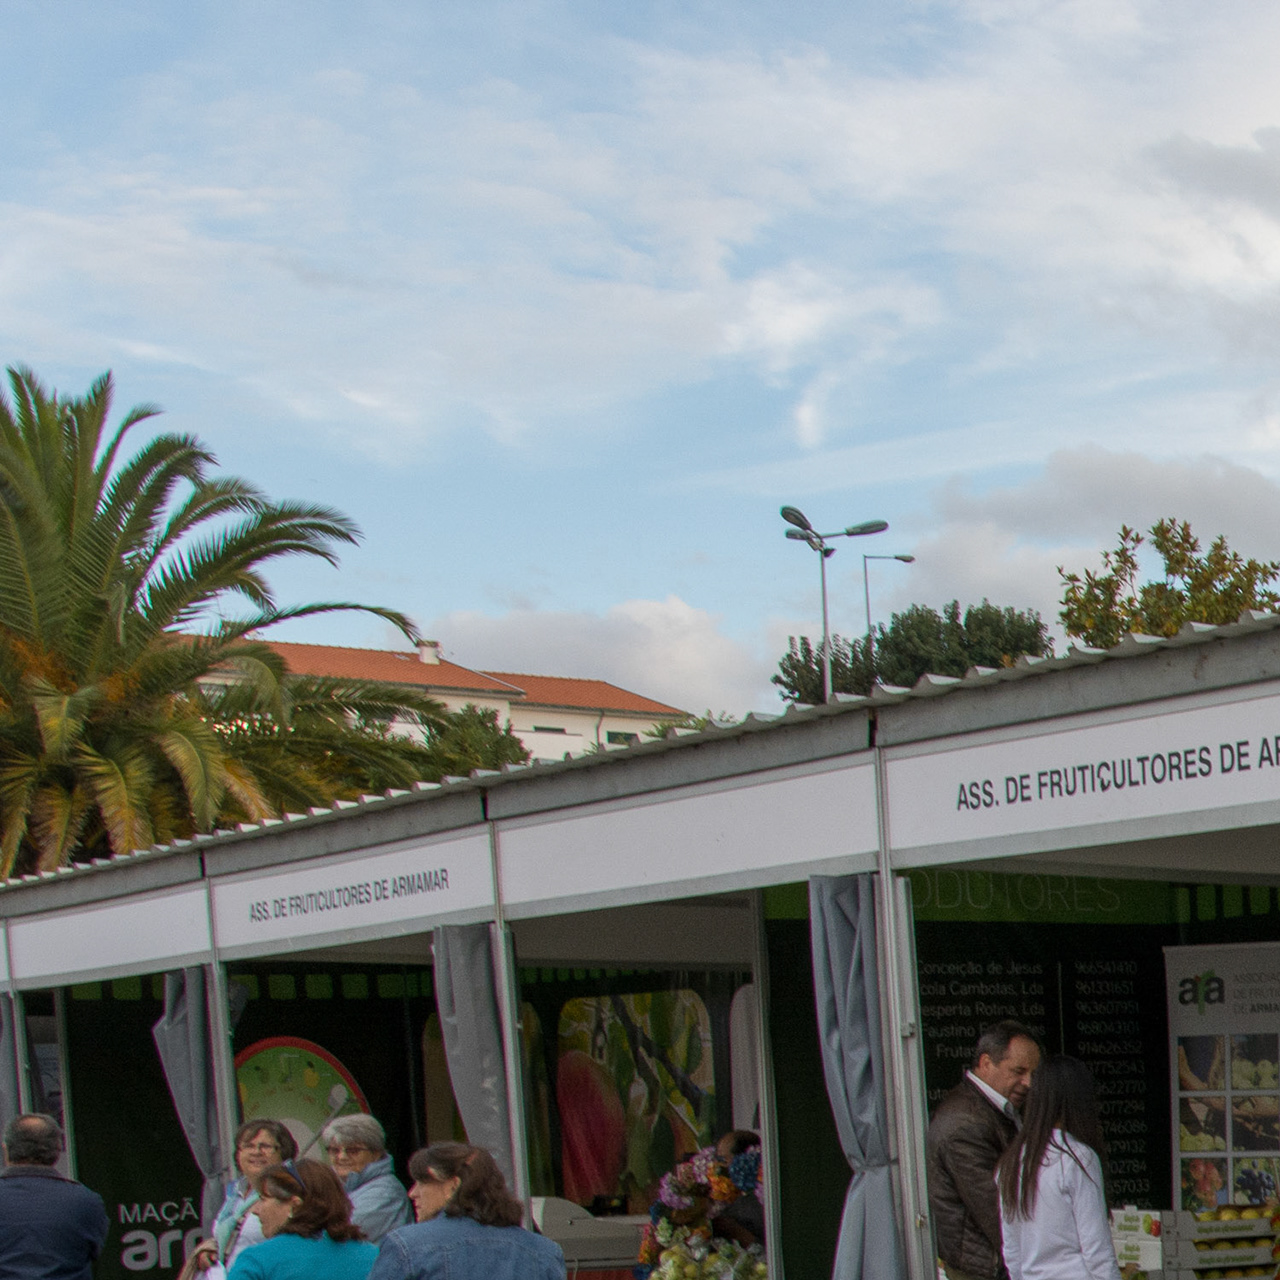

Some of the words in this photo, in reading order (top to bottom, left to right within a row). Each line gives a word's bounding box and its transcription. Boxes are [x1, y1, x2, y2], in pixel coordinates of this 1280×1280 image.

[957, 780, 999, 811] ASS.
[1005, 774, 1031, 804] DE
[1038, 747, 1212, 800] FRUTICULTORES
[1220, 741, 1250, 773] DE
[250, 903, 271, 923] ASS.
[274, 898, 288, 918] DE
[289, 883, 371, 916] FRUTICULTORES
[374, 880, 389, 900] DE
[391, 868, 449, 898] ARMAMAR
[987, 961, 1003, 975] de
[1006, 960, 1043, 975] Jesus
[1022, 982, 1044, 995] Lda
[1022, 1002, 1045, 1016] Lda
[119, 1197, 200, 1227] MAÇÃ
